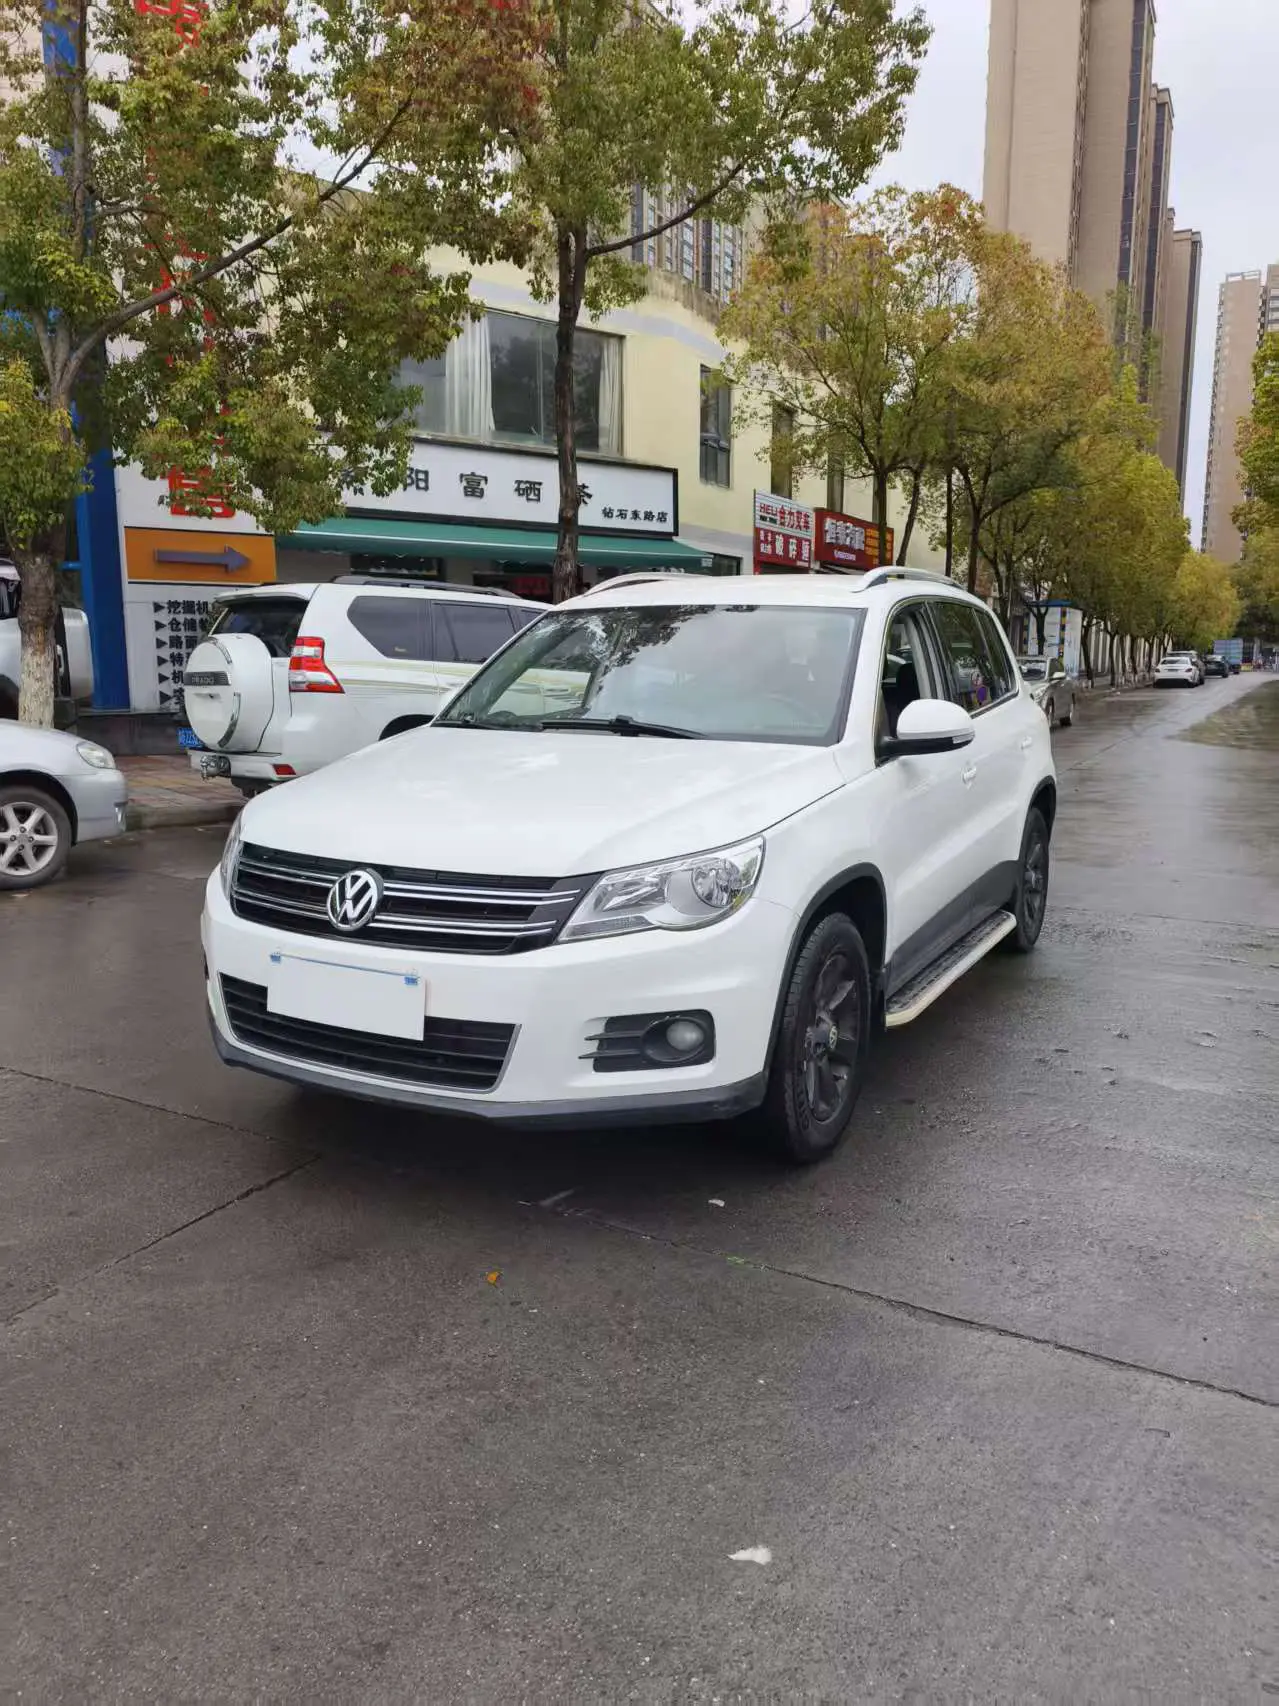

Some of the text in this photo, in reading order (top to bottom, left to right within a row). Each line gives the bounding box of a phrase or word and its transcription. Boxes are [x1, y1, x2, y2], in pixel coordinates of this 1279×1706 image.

[601, 505, 669, 523] 钻石东路店
[167, 600, 209, 616] 挖掘机
